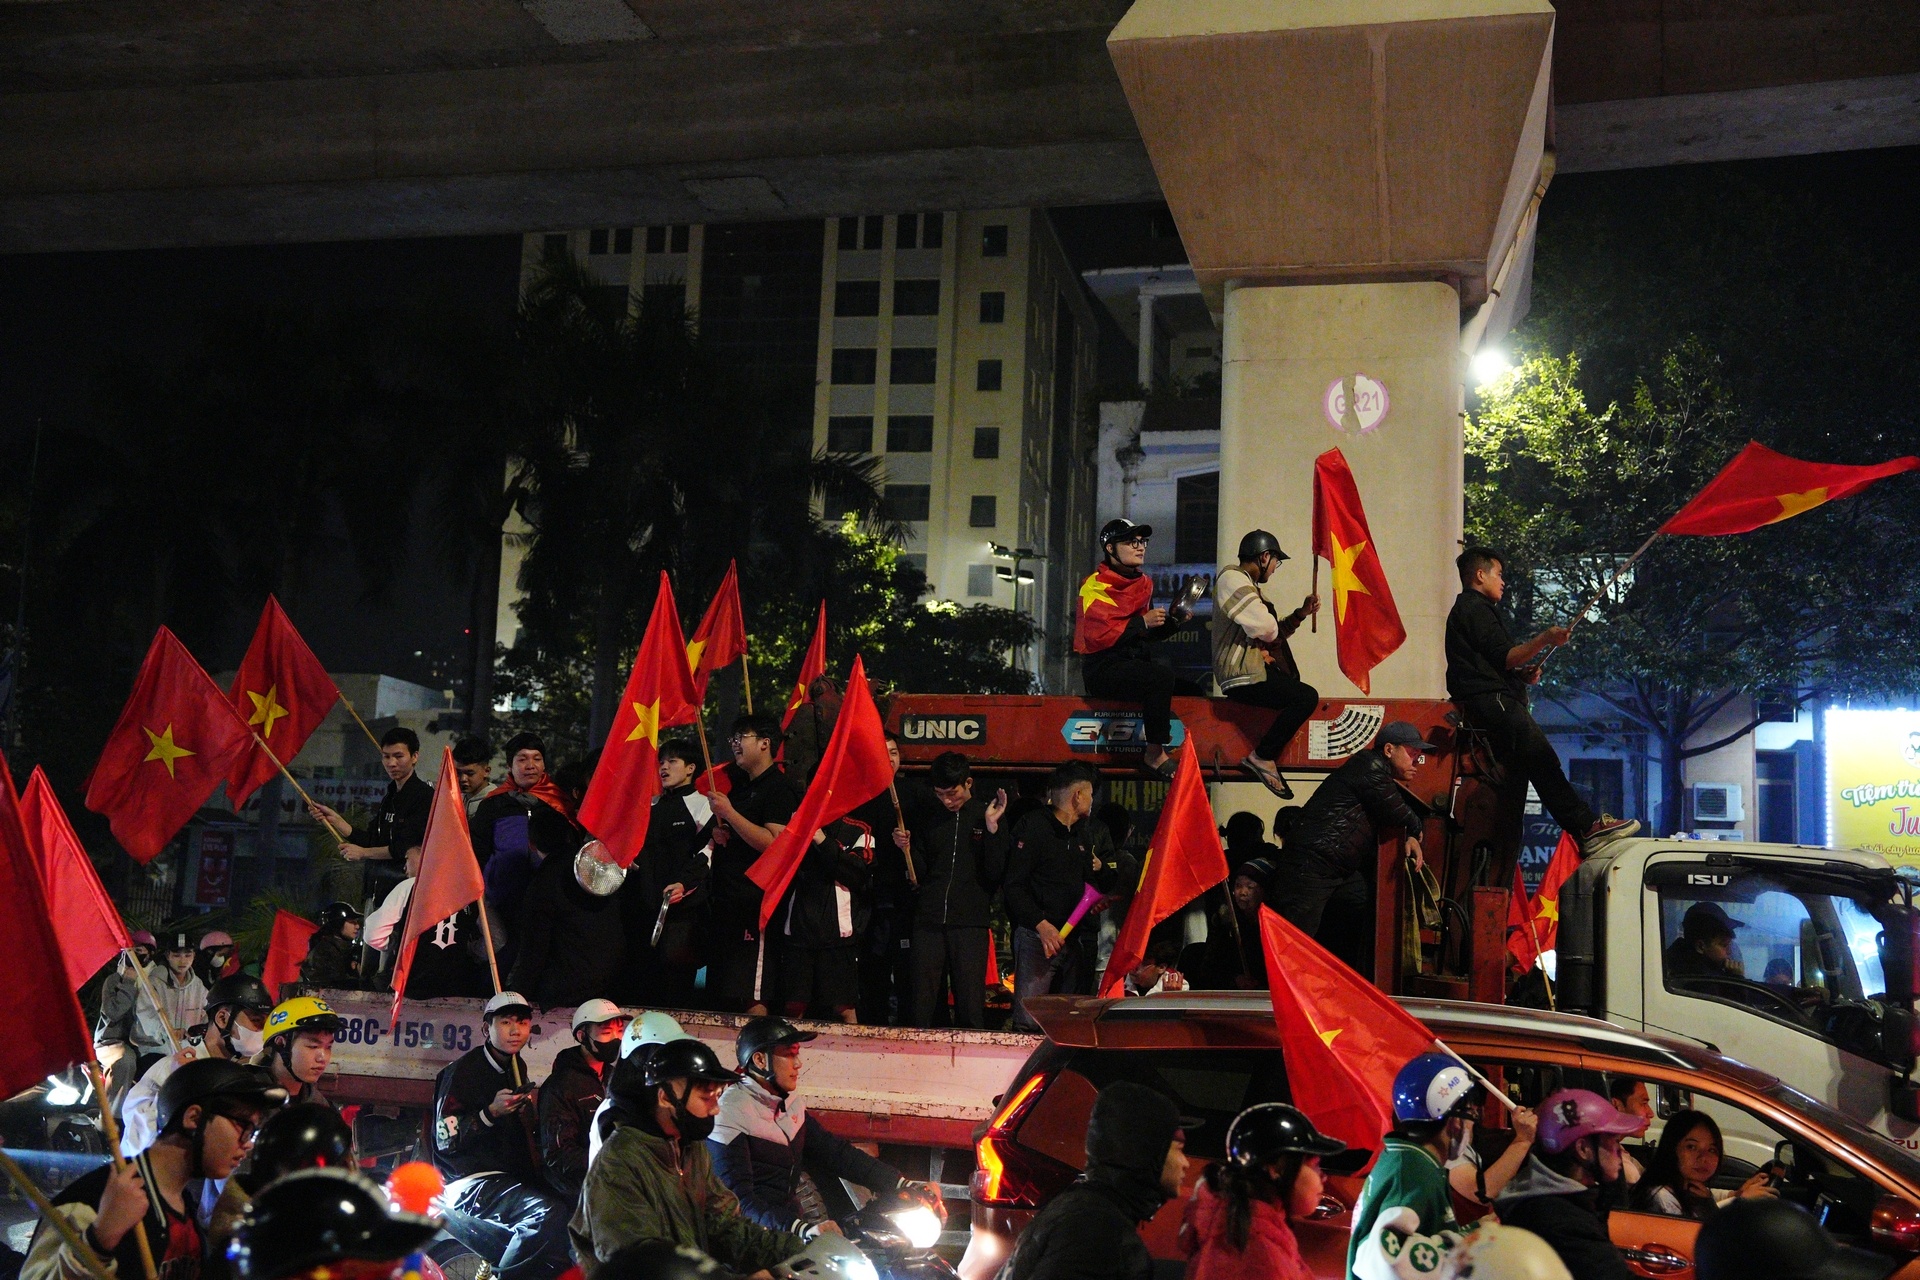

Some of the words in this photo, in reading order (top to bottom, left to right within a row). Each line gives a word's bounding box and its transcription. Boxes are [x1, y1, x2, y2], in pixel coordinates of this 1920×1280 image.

[903, 719, 980, 740] UNIC
[1841, 784, 1896, 808] Tiệm
[270, 1011, 288, 1026] be
[1447, 1076, 1461, 1090] MB
